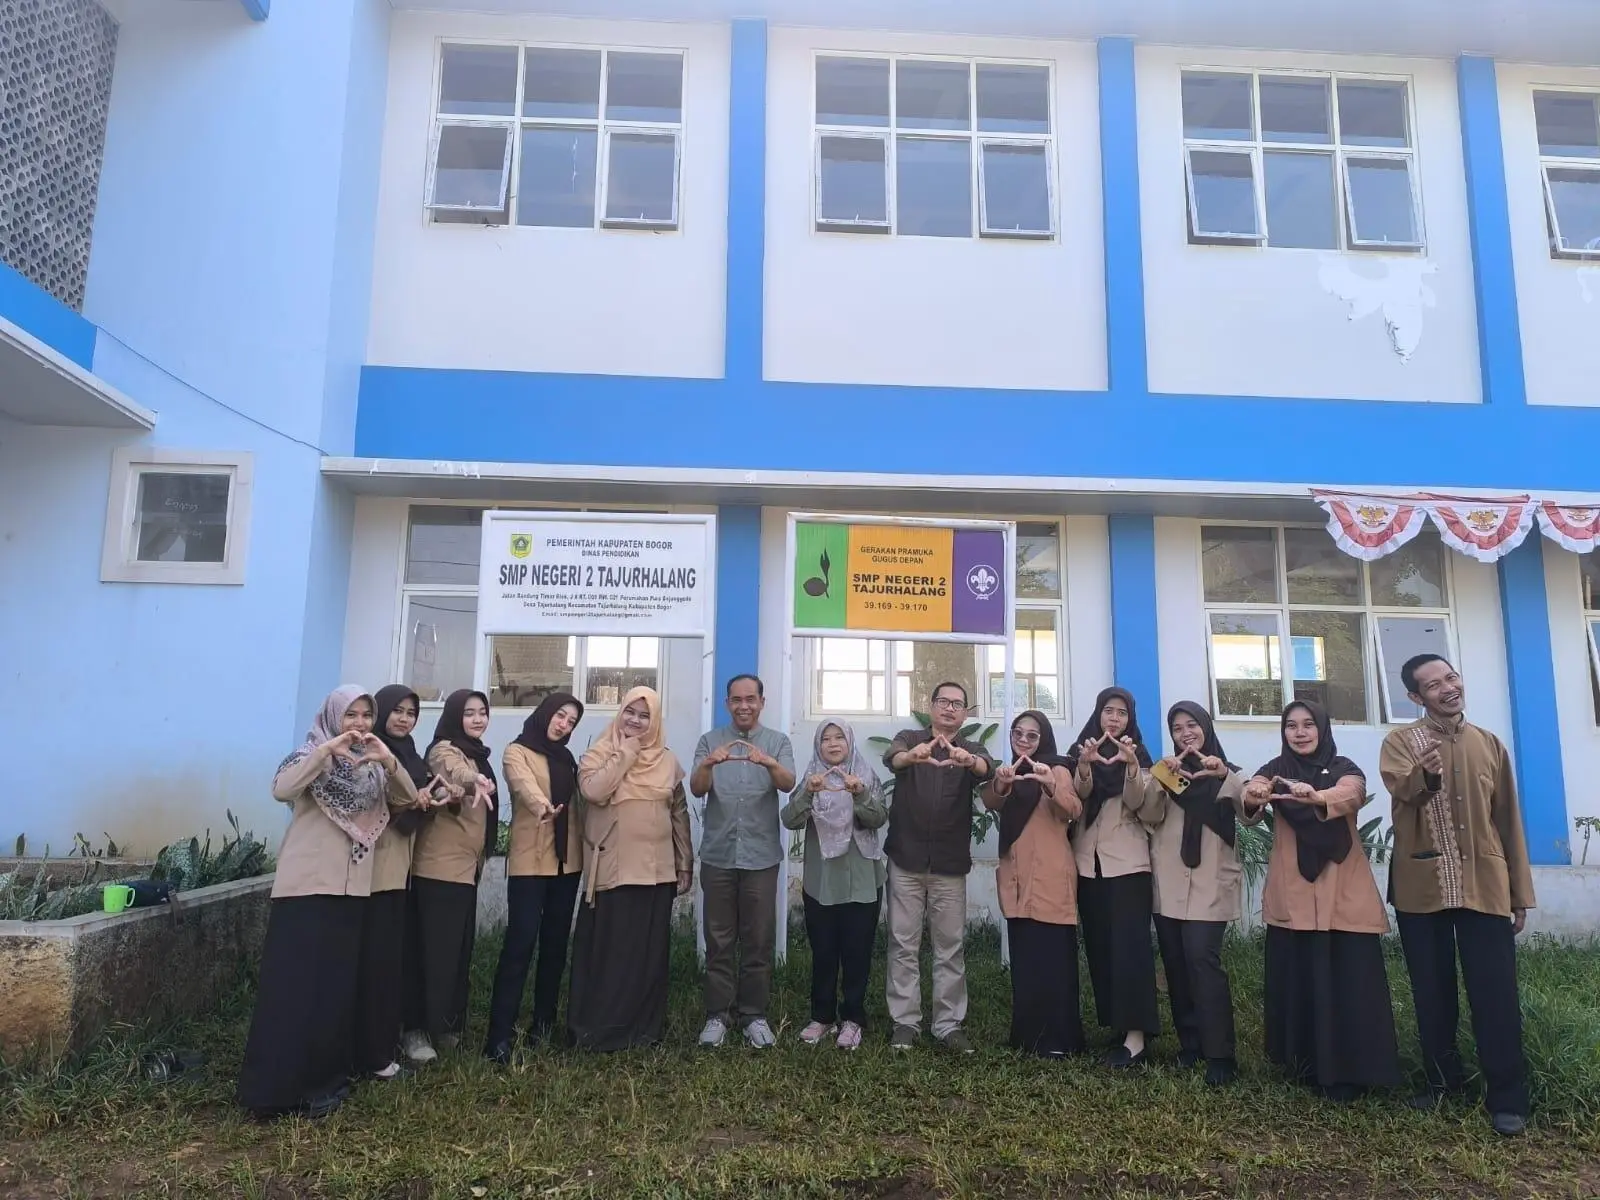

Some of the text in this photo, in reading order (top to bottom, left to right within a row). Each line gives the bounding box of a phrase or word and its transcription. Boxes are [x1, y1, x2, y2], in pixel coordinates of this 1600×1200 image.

[546, 539, 673, 549] PEMERINTAH KABUPATEN BOGOR
[860, 546, 934, 556] GERAKAN PRAMUKA
[872, 555, 924, 564] GUGUS DEPAN
[499, 564, 696, 589] SMP NEGERI 2 TAJURHALANG
[853, 573, 946, 585] SMP NEGERI 2
[853, 584, 946, 597] TAJURHALANG
[864, 601, 892, 610] 39.169
[900, 602, 928, 611] 39.170
